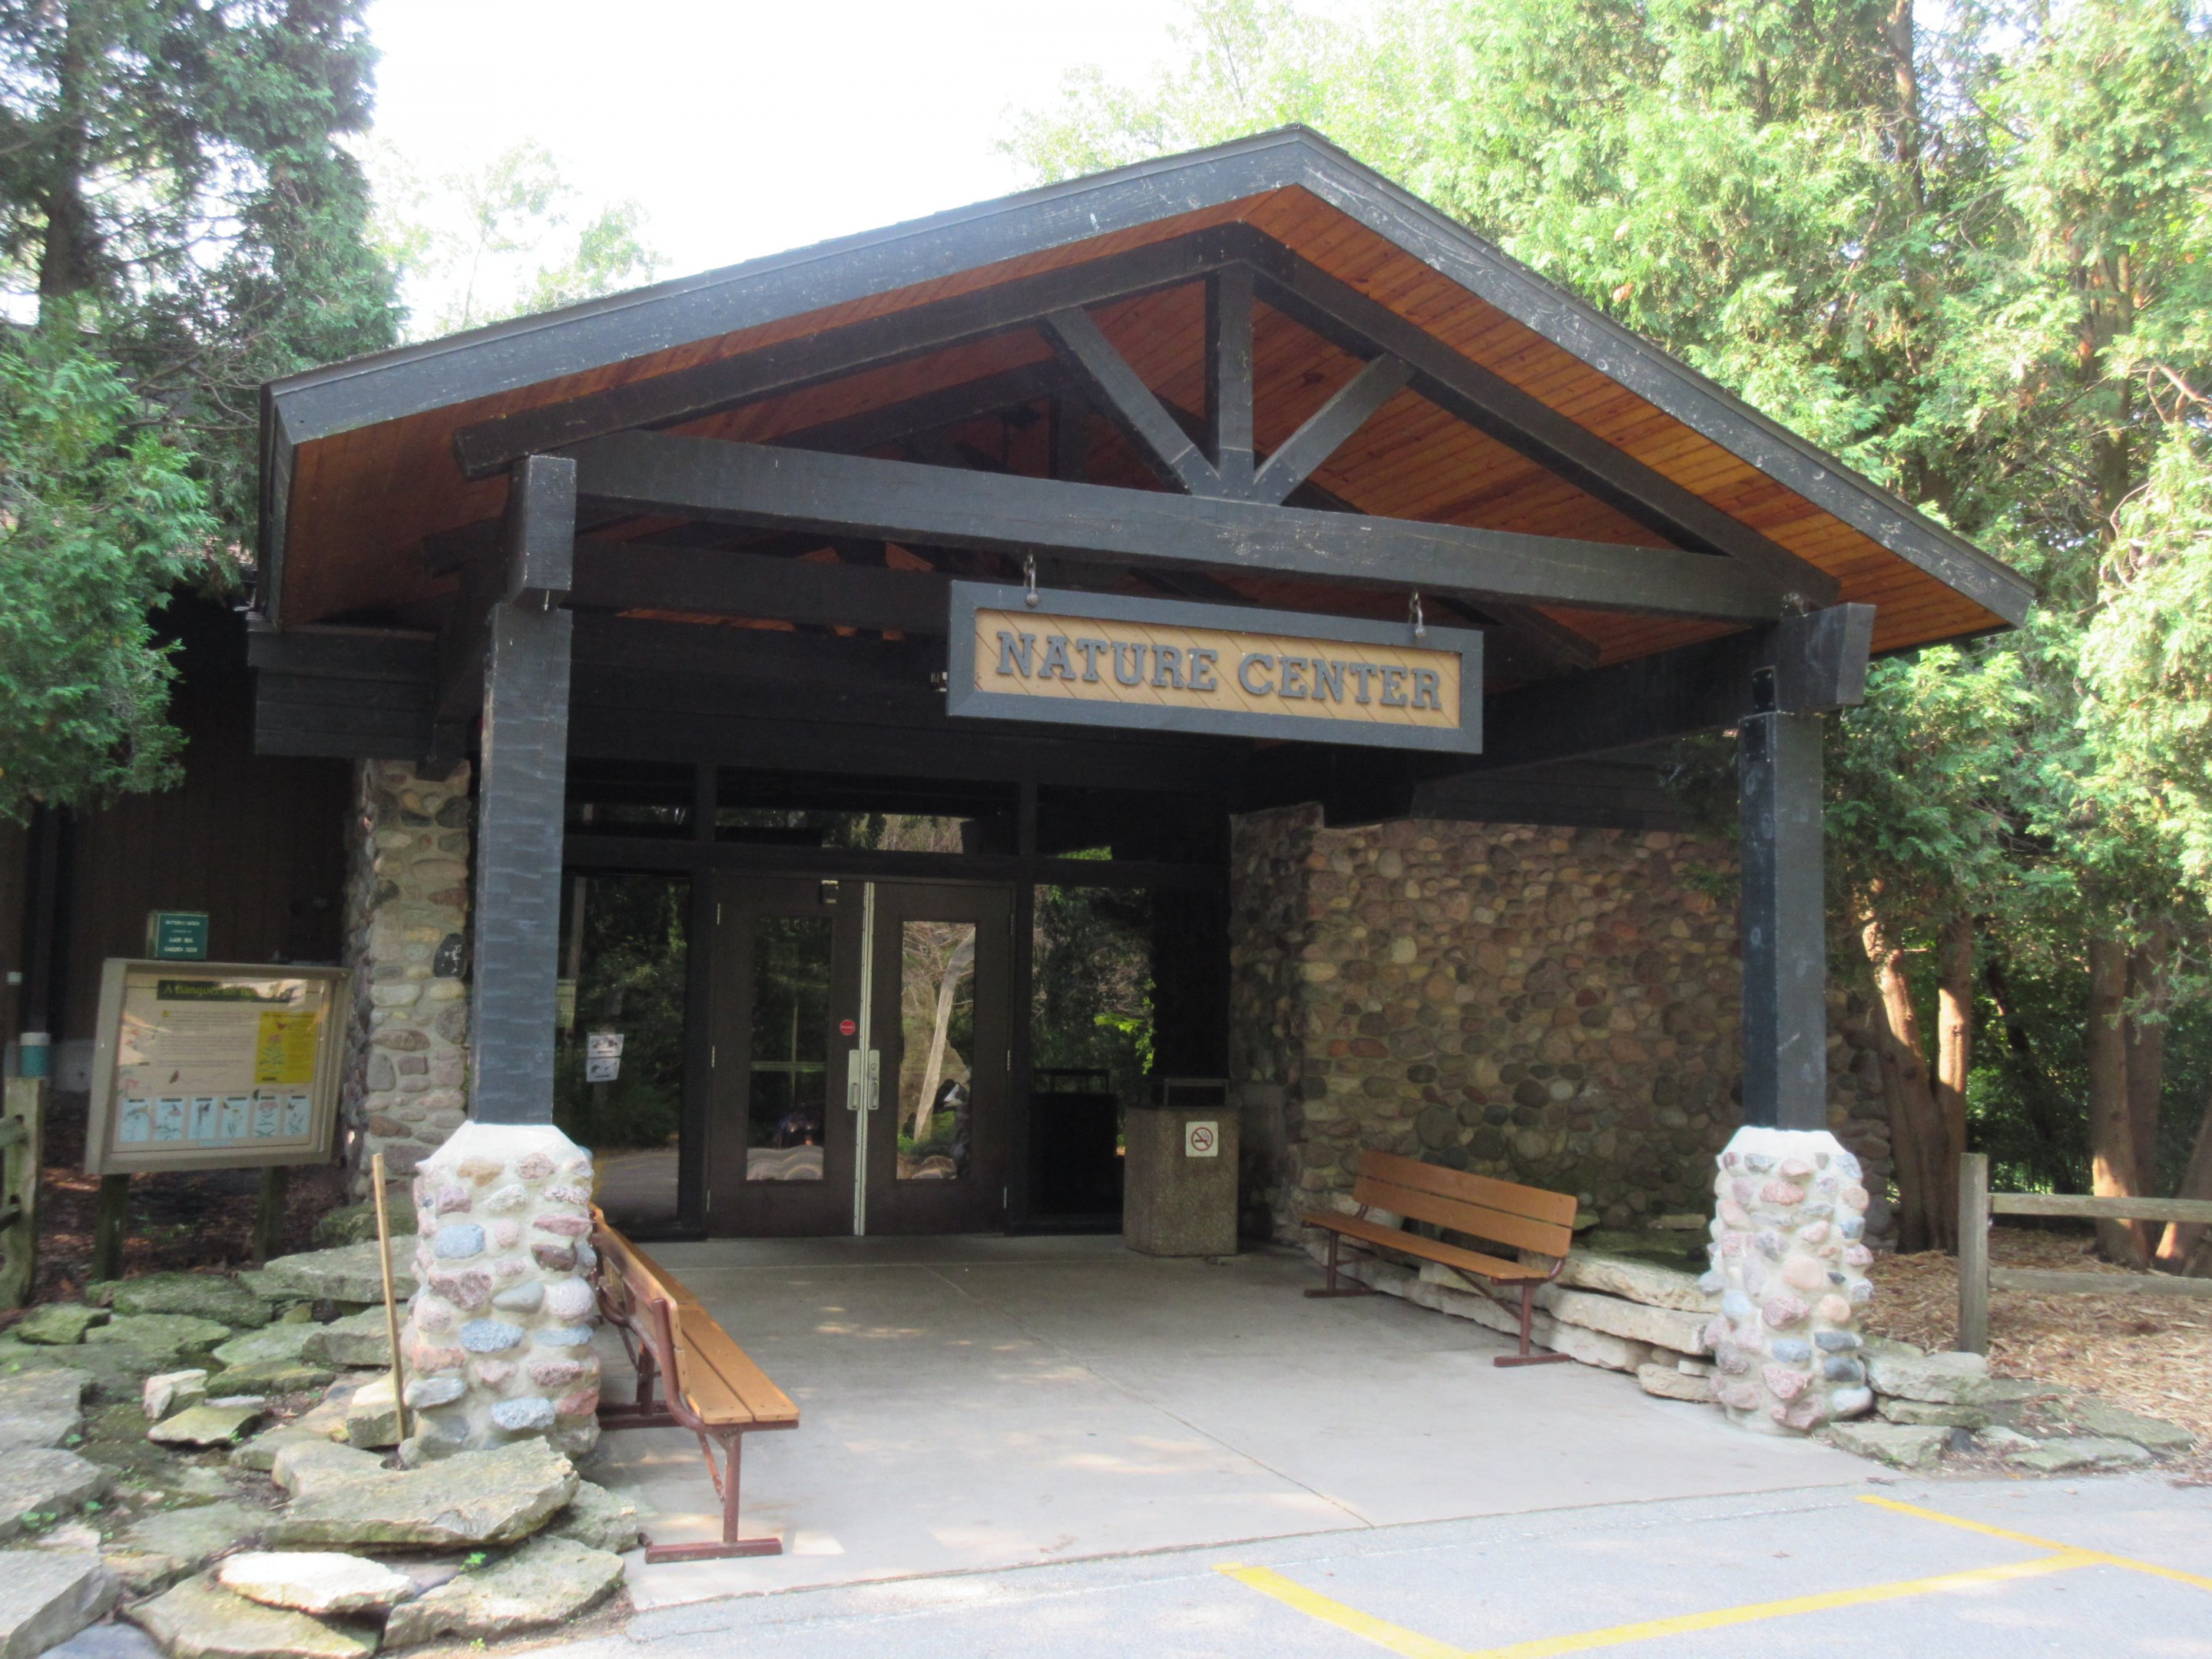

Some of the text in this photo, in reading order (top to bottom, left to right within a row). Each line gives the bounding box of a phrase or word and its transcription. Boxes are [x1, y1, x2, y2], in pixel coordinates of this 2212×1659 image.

[996, 631, 1443, 710] NATURE CENTER
[176, 984, 221, 997] Banque
